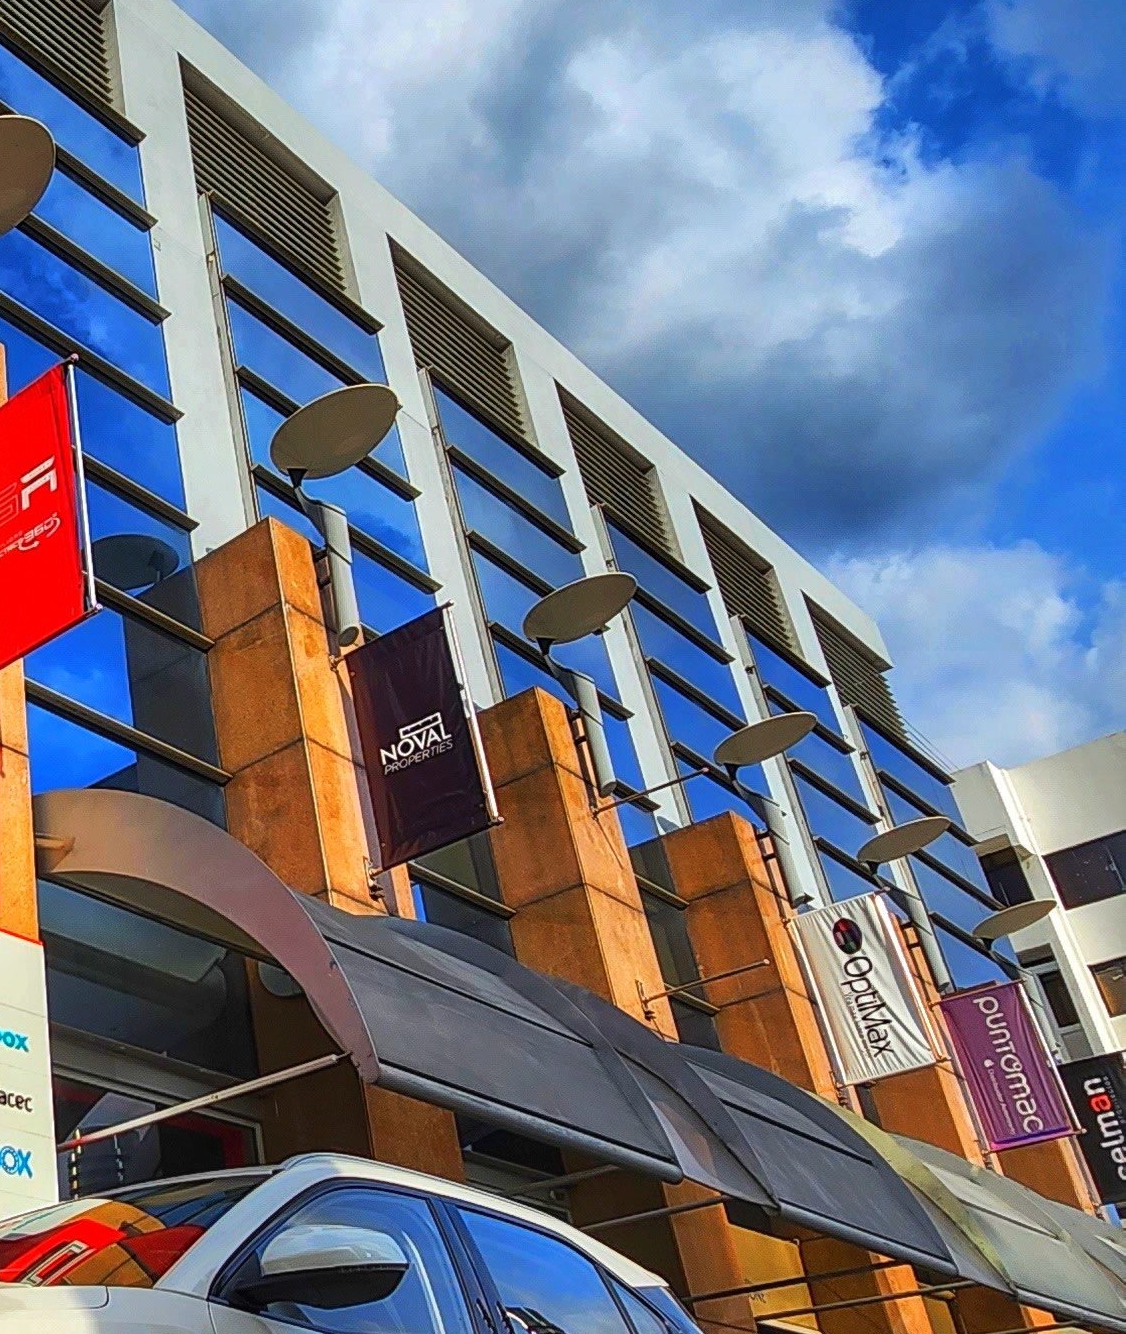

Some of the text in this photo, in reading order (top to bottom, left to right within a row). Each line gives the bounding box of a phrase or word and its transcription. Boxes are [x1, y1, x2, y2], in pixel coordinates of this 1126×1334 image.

[379, 723, 452, 766] NOVAL
[384, 738, 454, 776] PROPERTIES
[840, 956, 895, 1058] OptiMax
